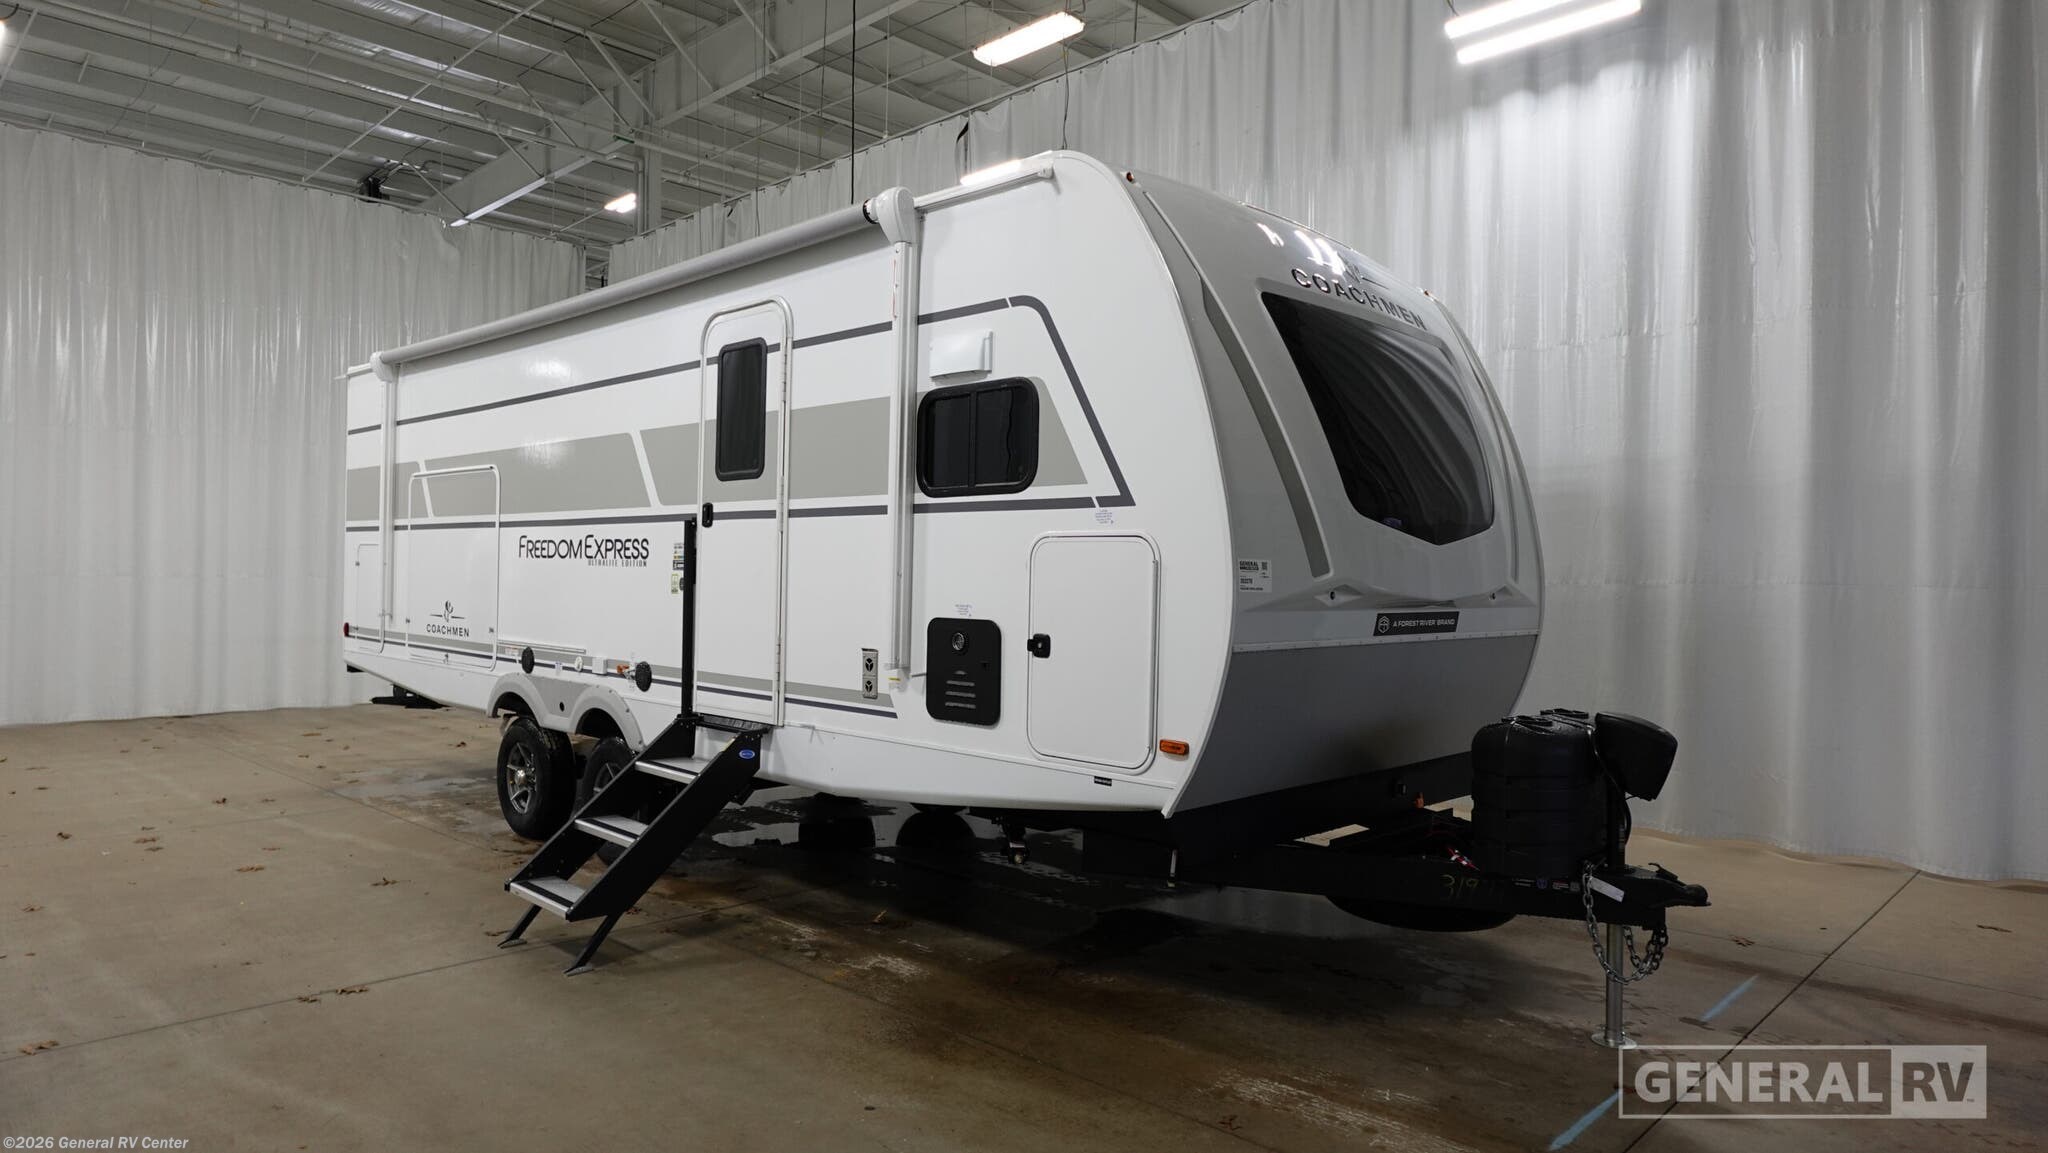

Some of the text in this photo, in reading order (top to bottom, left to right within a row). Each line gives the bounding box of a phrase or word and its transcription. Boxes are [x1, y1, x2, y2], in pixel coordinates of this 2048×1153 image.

[1290, 267, 1427, 330] COACHMEN
[518, 535, 583, 559] FREEDOM
[584, 534, 649, 560] EXPRESS
[621, 559, 647, 567] EDITION
[1398, 619, 1418, 627] FOREST
[1437, 618, 1456, 626] BRAND
[426, 623, 470, 637] COACHMEN
